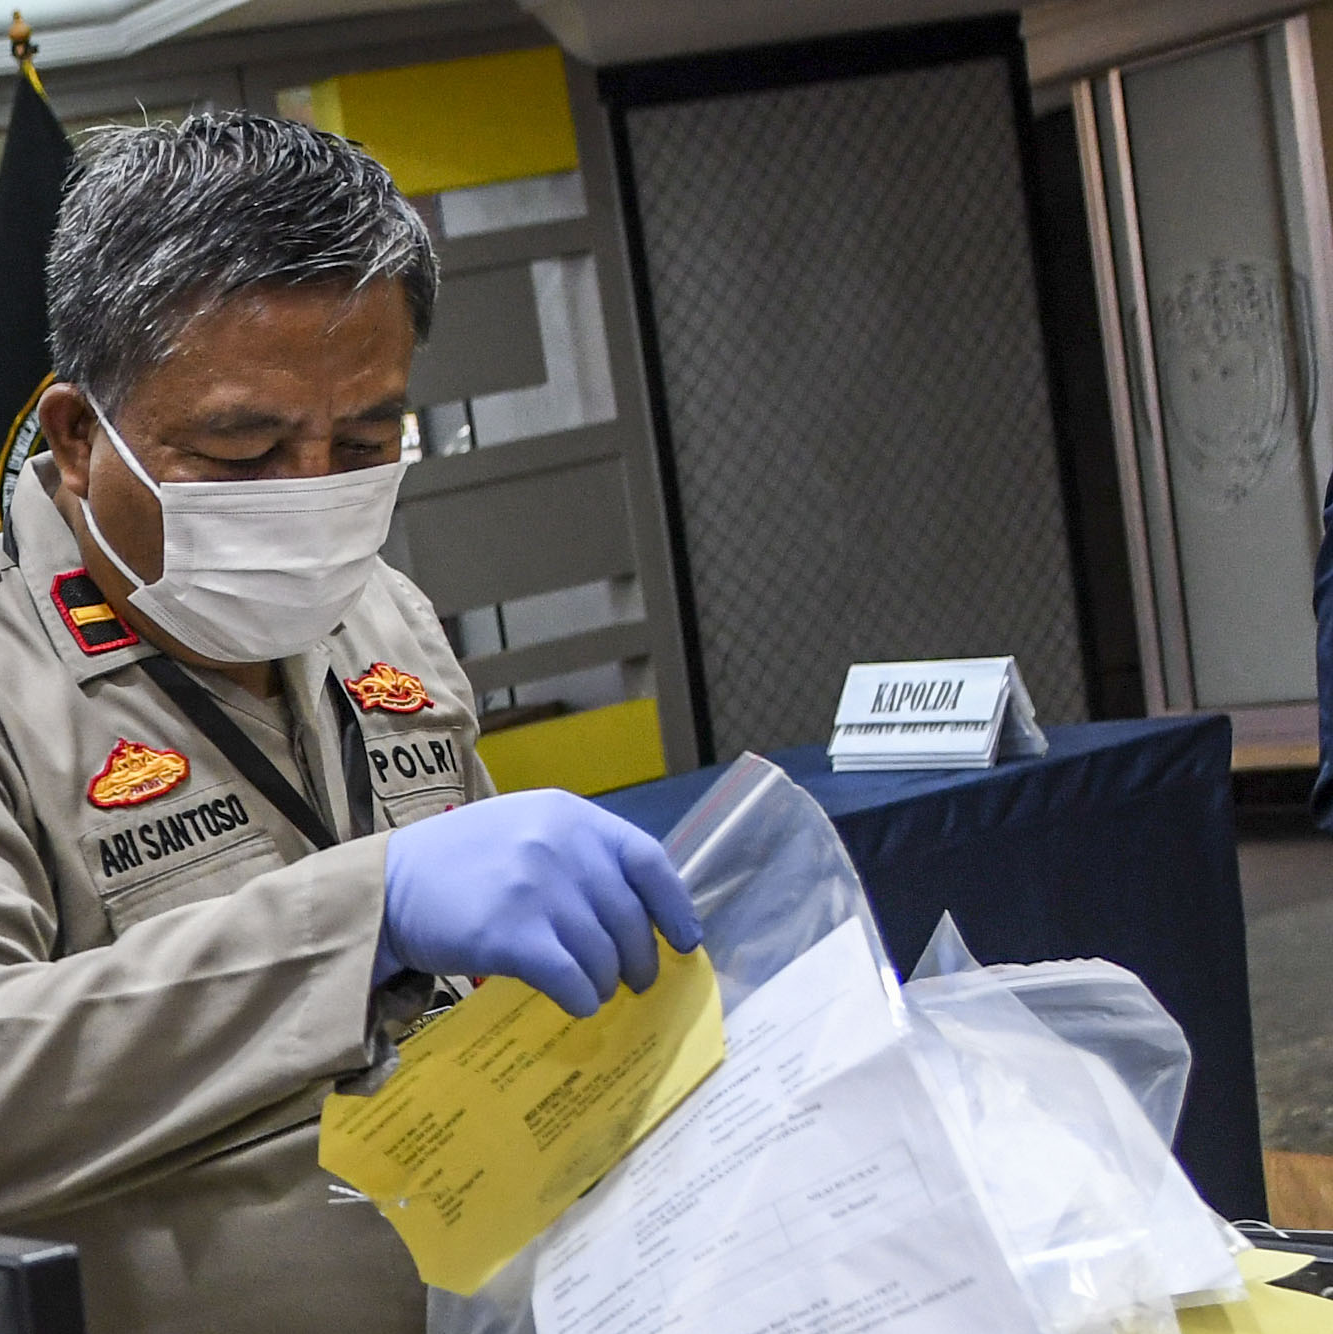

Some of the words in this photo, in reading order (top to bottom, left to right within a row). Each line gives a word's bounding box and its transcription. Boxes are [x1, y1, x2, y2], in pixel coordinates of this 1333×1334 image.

[871, 680, 965, 714] KAPOLDA
[368, 738, 458, 783] POLRI
[99, 829, 144, 878] ARI
[138, 793, 250, 861] SANTOSO
